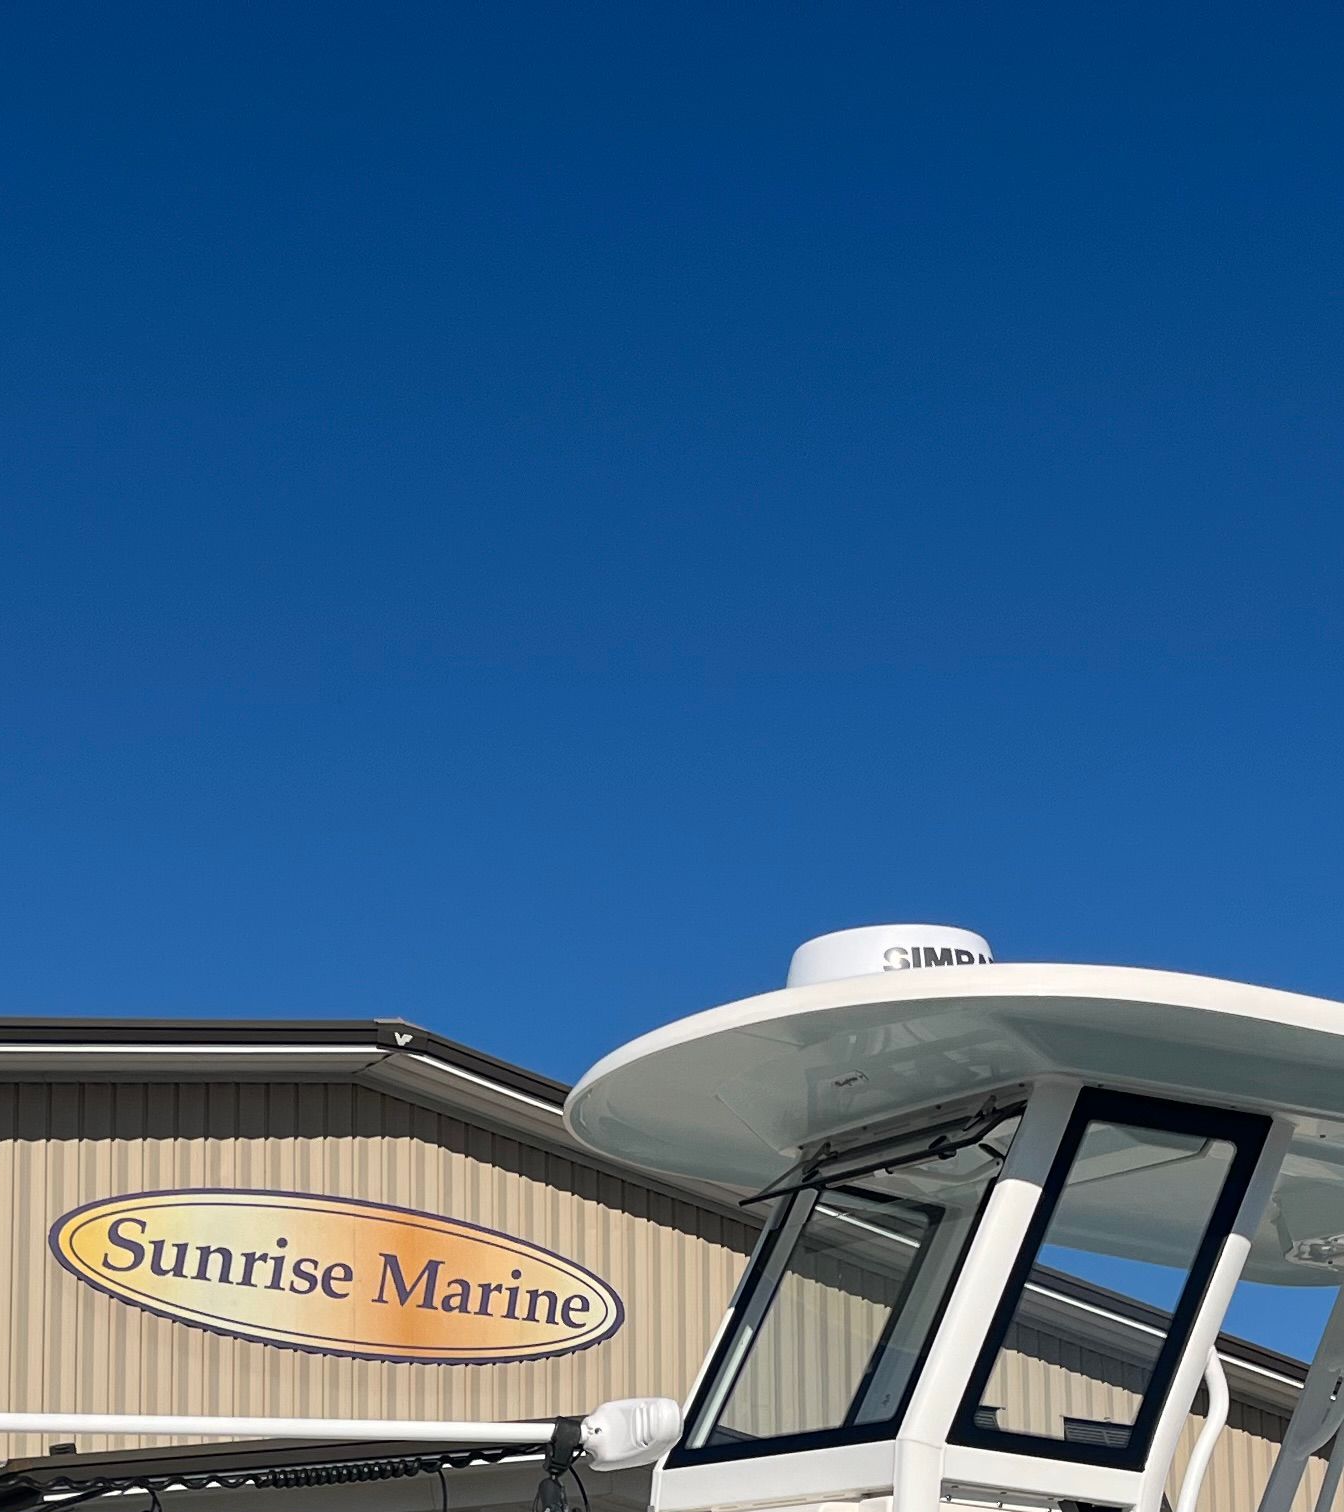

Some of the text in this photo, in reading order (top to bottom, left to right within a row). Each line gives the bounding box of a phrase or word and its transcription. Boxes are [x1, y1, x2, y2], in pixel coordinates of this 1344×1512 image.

[883, 946, 994, 972] SIMR
[102, 1217, 591, 1329] Sunrise Marine
